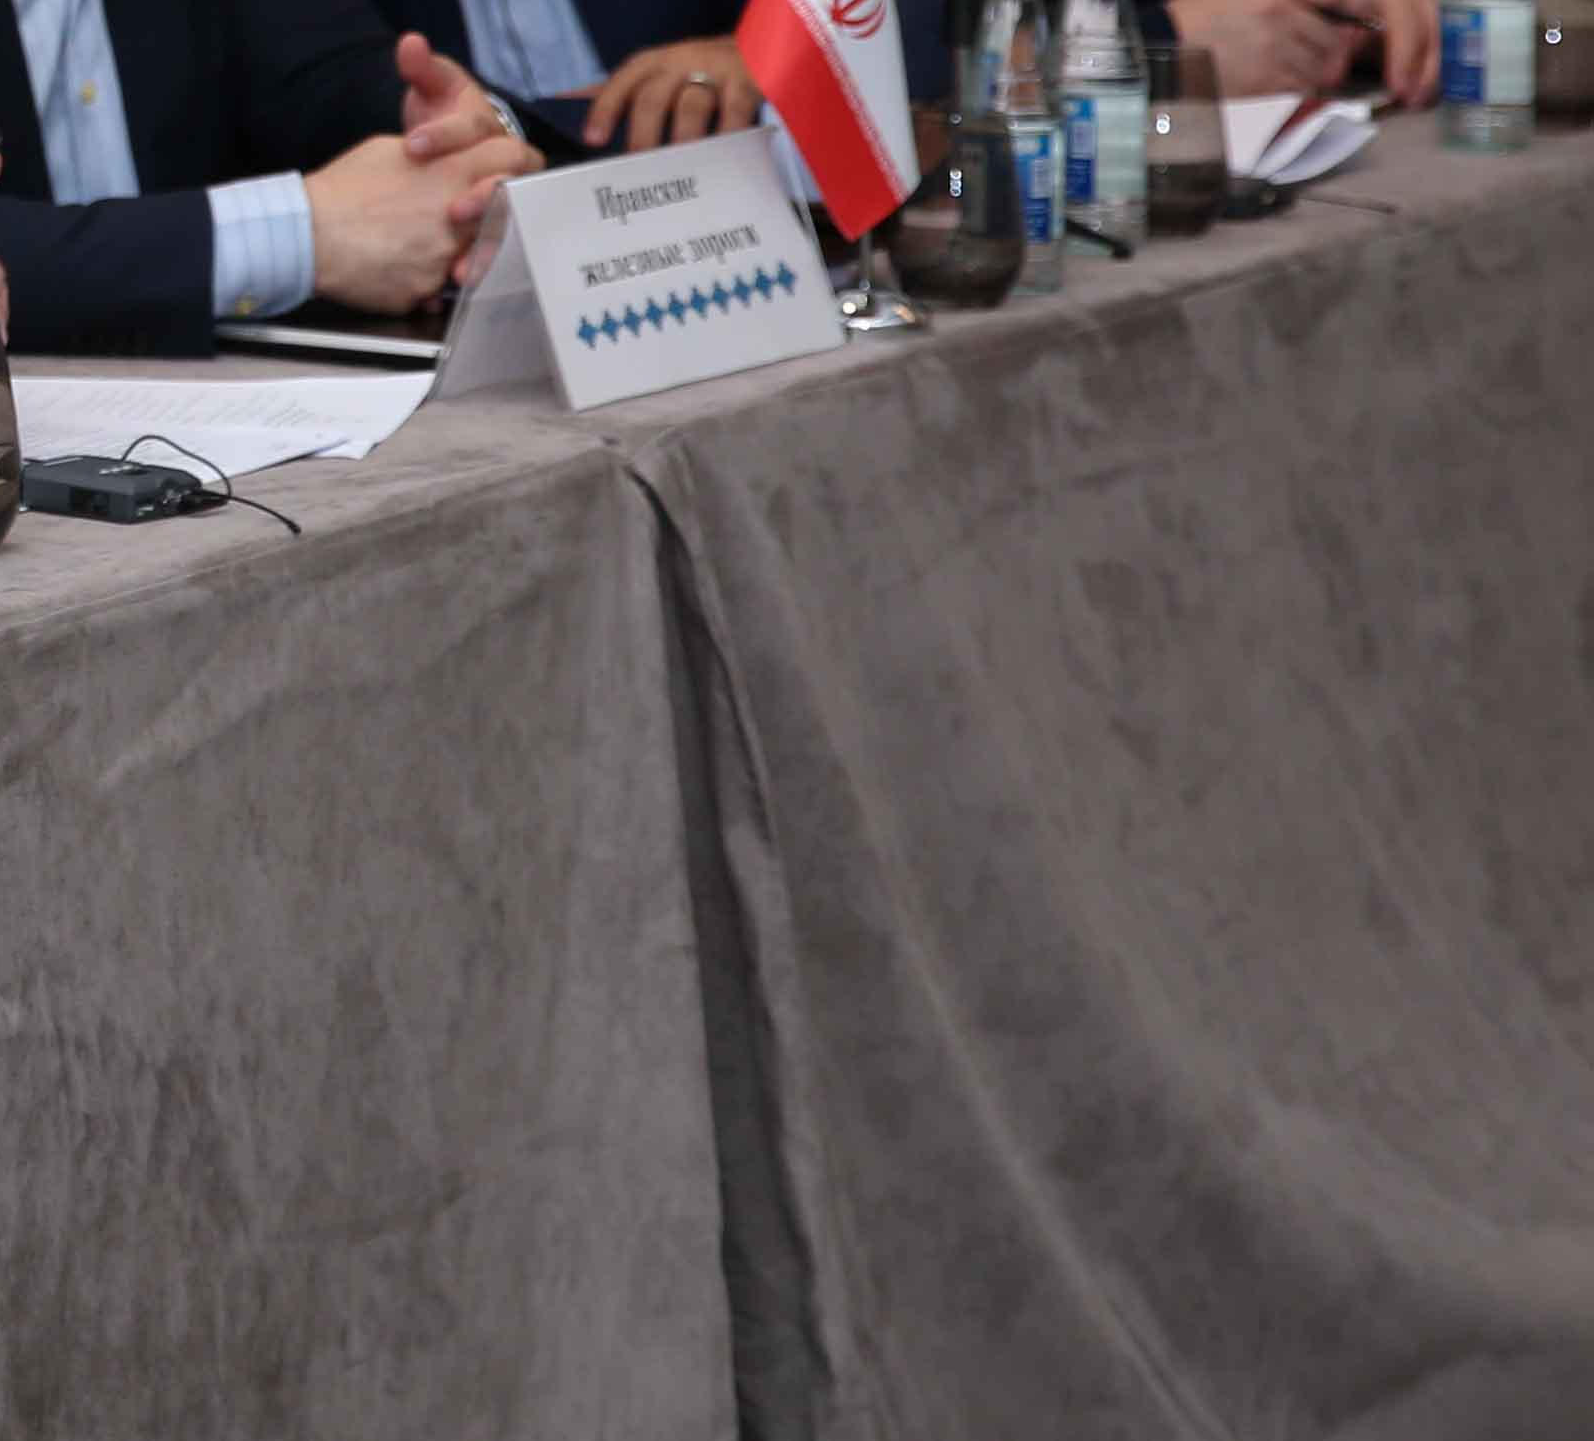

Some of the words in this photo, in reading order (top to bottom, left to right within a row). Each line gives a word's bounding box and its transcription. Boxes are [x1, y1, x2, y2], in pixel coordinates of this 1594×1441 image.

[594, 176, 700, 225] Иранские
[580, 243, 686, 287] железные
[688, 223, 761, 264] дороги
